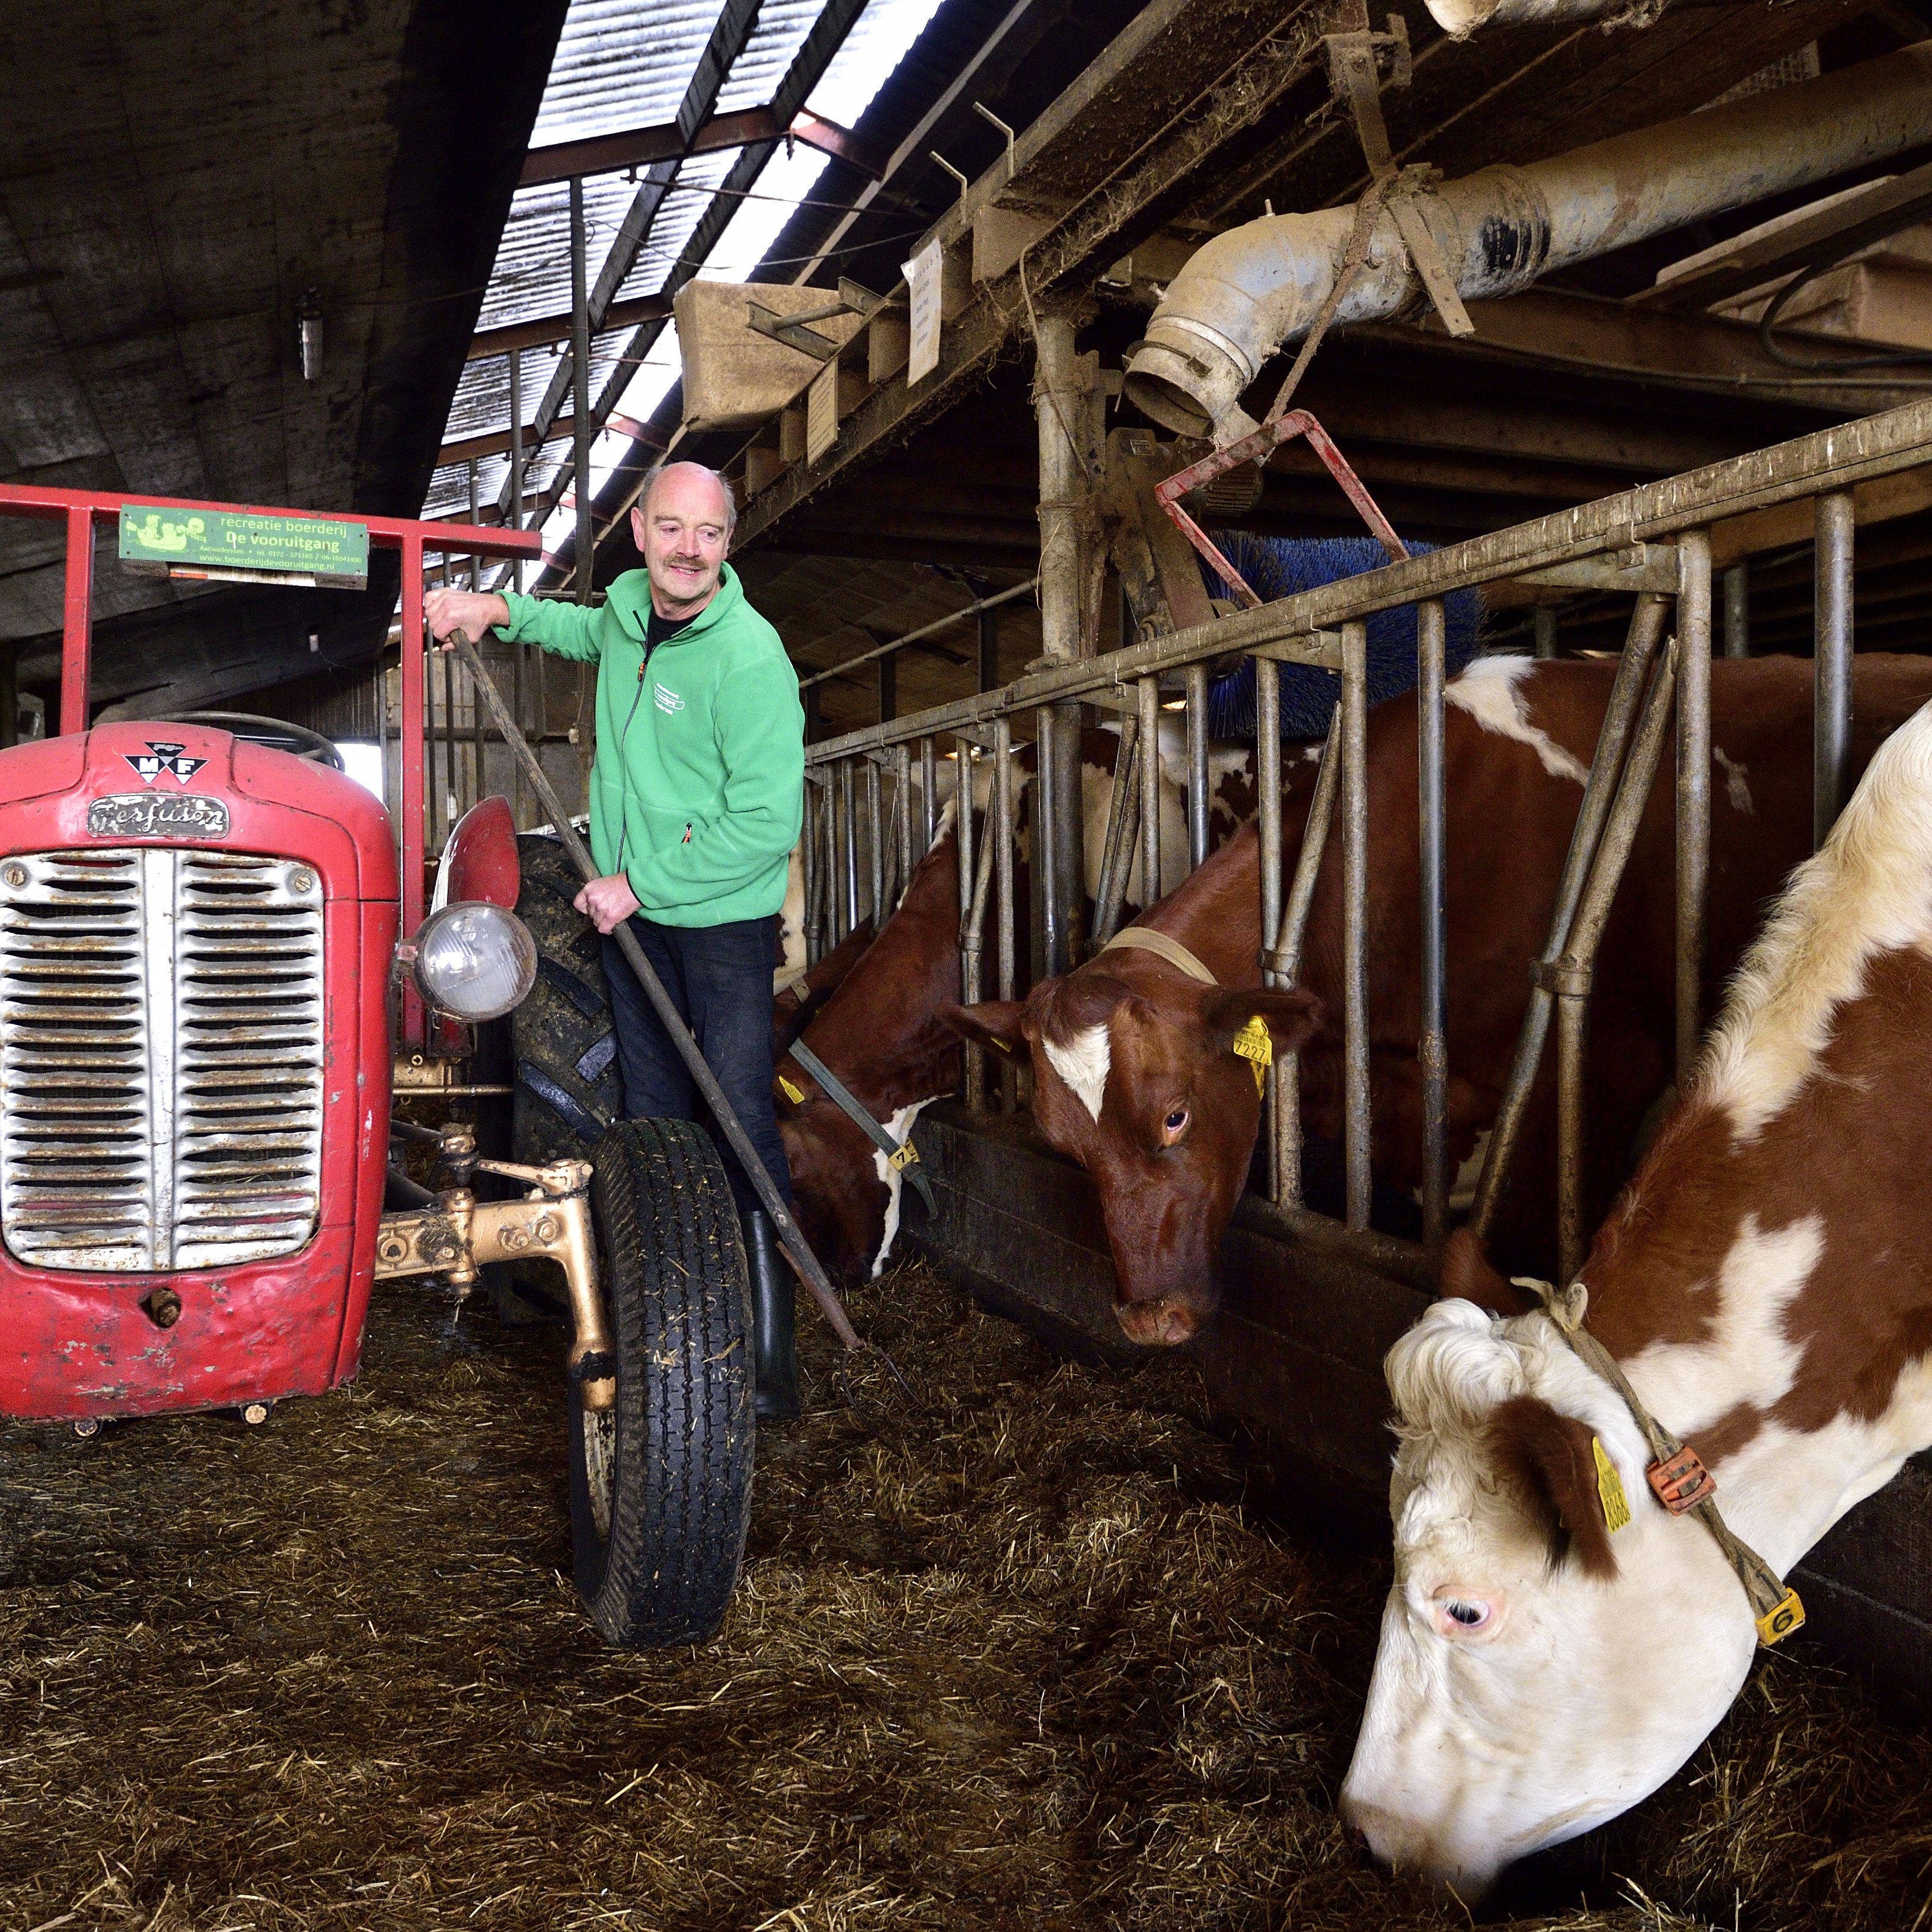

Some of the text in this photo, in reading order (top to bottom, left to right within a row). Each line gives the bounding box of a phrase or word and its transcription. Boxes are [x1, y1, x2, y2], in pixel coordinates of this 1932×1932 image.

[221, 518, 346, 538] recreatie boerderij
[226, 531, 340, 553] De vooruitgang
[199, 555, 334, 570] www.boerderijdevooruitgang.nl
[139, 758, 194, 773] M F
[1236, 1040, 1265, 1061] 7227
[1606, 1491, 1628, 1531] 8368
[1773, 1608, 1794, 1633] 6
